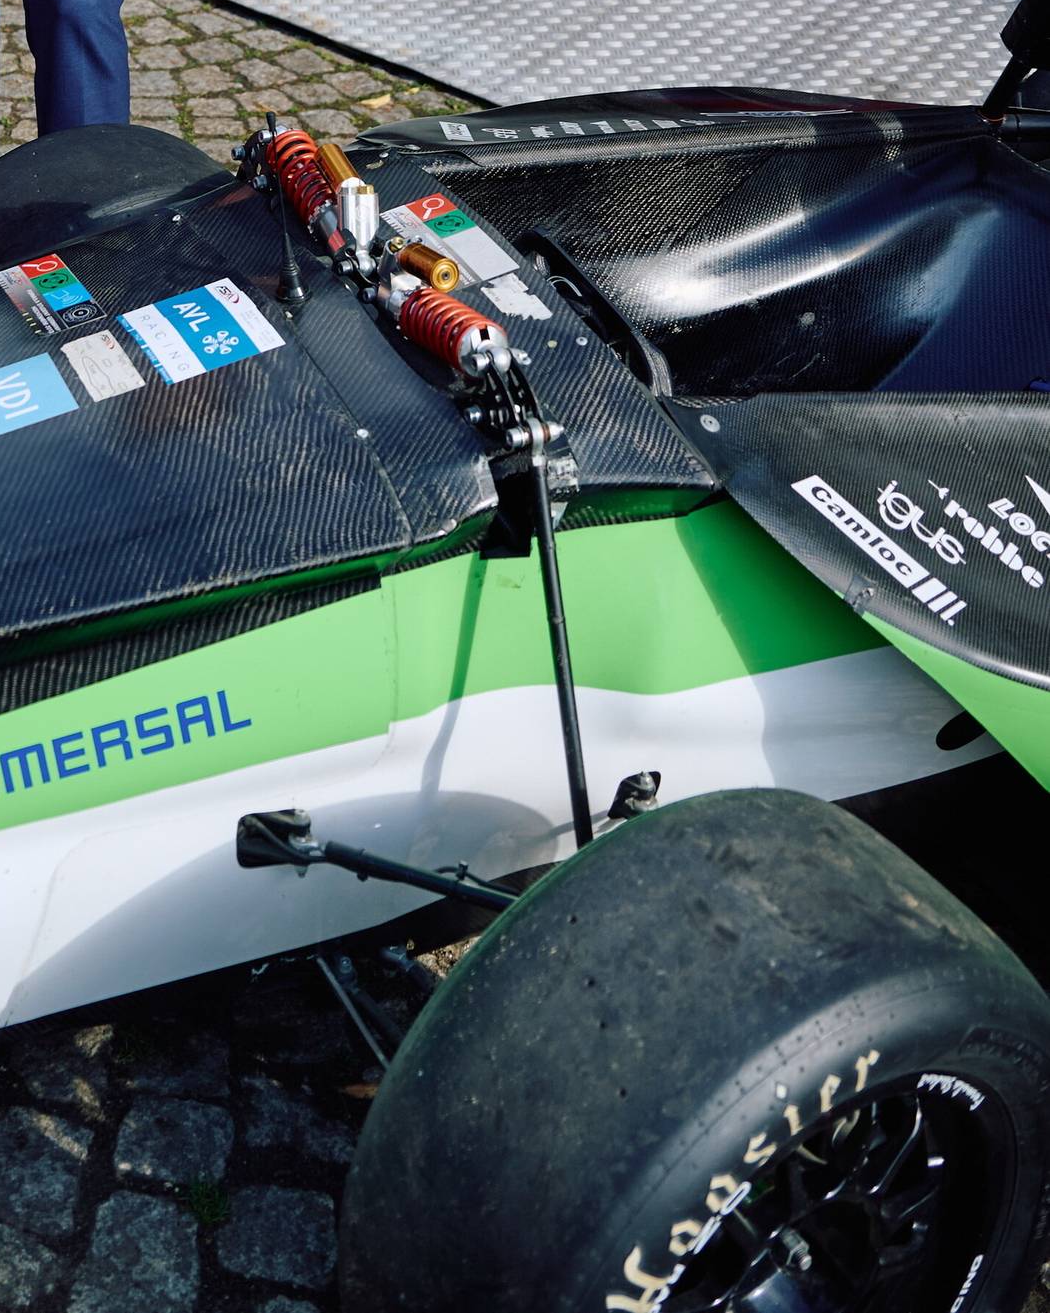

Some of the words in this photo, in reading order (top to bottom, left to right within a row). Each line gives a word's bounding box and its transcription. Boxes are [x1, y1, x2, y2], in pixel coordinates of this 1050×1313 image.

[141, 315, 191, 371] RACING
[172, 301, 212, 334] AVL
[876, 480, 967, 565] igus
[944, 499, 1044, 588] robbe
